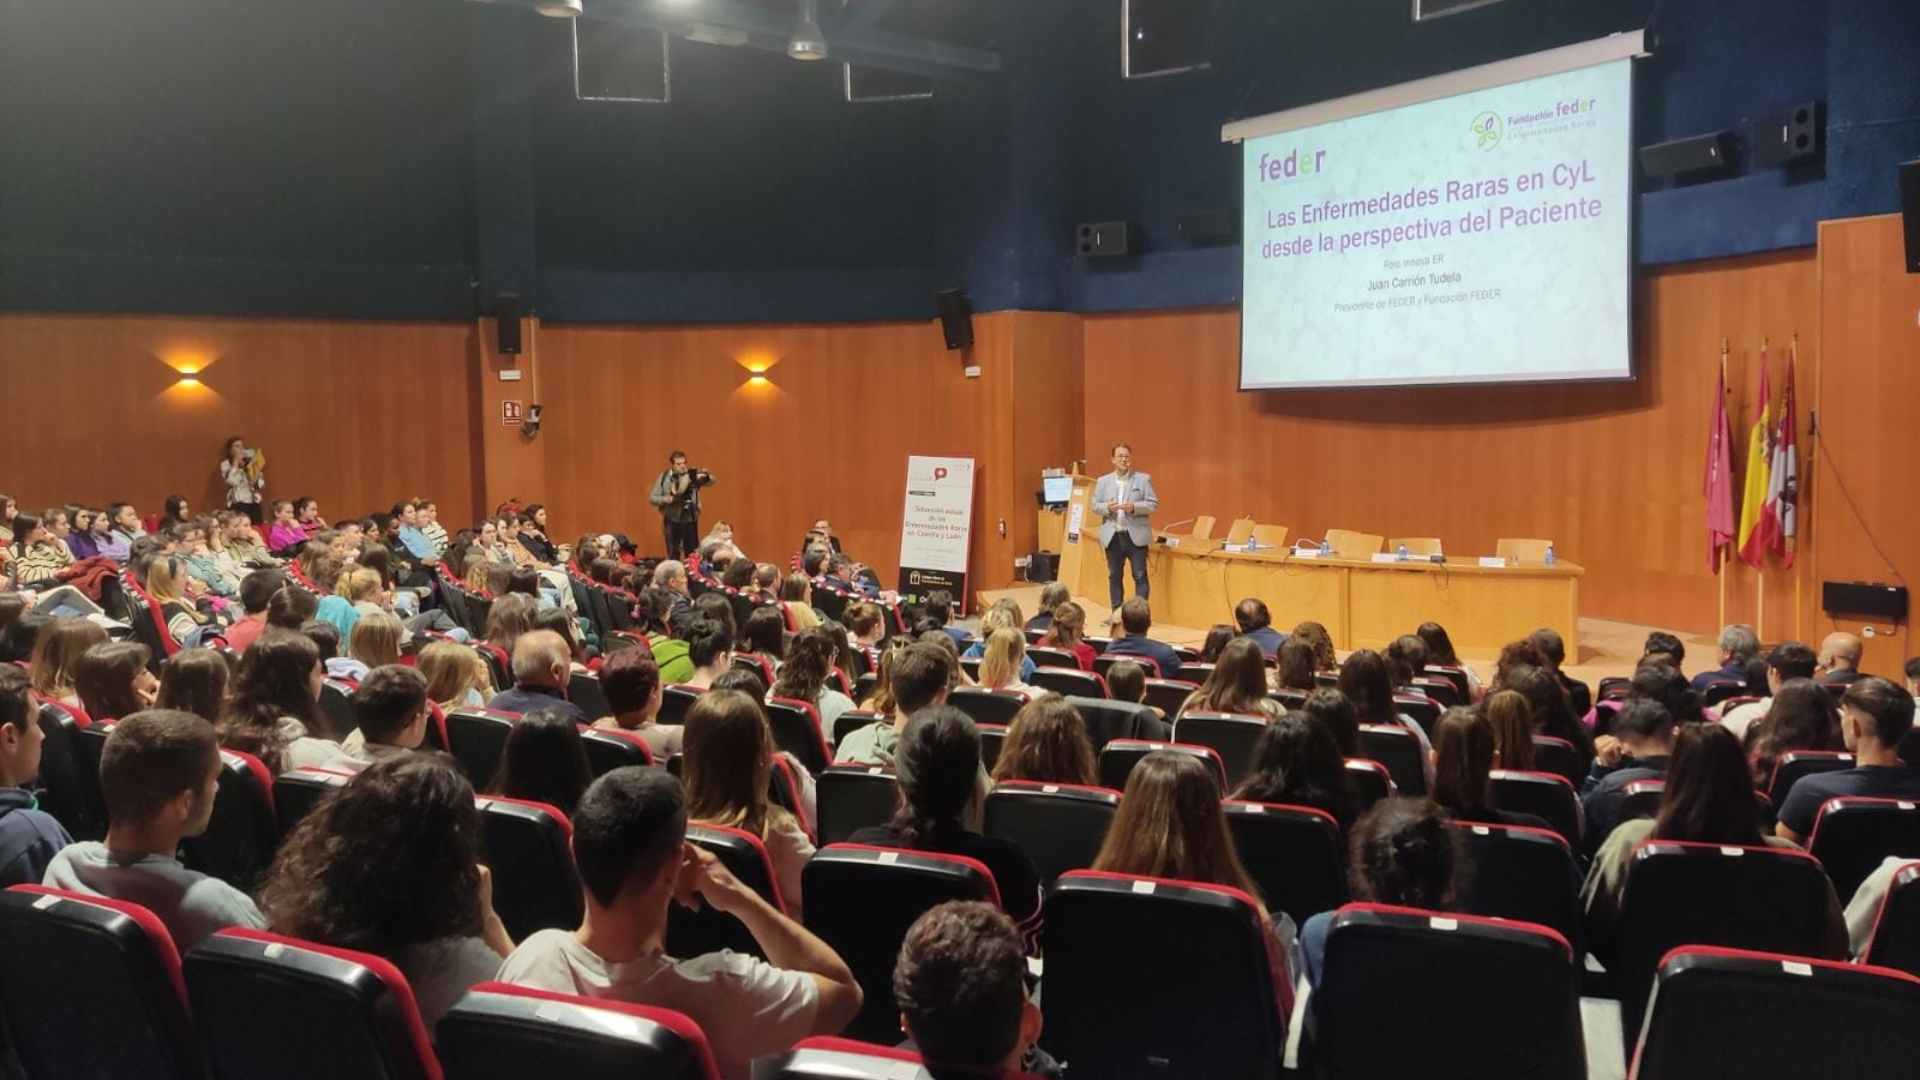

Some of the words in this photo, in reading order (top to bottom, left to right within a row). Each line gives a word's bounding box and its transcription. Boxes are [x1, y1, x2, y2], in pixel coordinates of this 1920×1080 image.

[1556, 98, 1596, 117] feder
[1259, 148, 1326, 182] feder
[1267, 210, 1296, 229] Las
[1302, 187, 1439, 225] Enfermedades
[1446, 177, 1509, 203] Raras
[1516, 172, 1544, 192] en
[1552, 159, 1595, 191] CyL
[1262, 234, 1312, 259] desde
[1319, 232, 1333, 252] la
[1340, 217, 1451, 254] perspectiva
[1459, 208, 1491, 234] del
[1500, 197, 1602, 229] Paciente
[1384, 259, 1401, 270] Foro
[1432, 253, 1444, 265] ER
[1367, 279, 1390, 292] Juan
[1391, 275, 1426, 289] Carrión
[1429, 271, 1462, 285] Tudela
[1334, 301, 1374, 313] Presidente
[1376, 298, 1386, 310] de
[1388, 296, 1416, 308] FEDER
[1424, 292, 1469, 306] Fundación
[1470, 288, 1501, 301] FEDER
